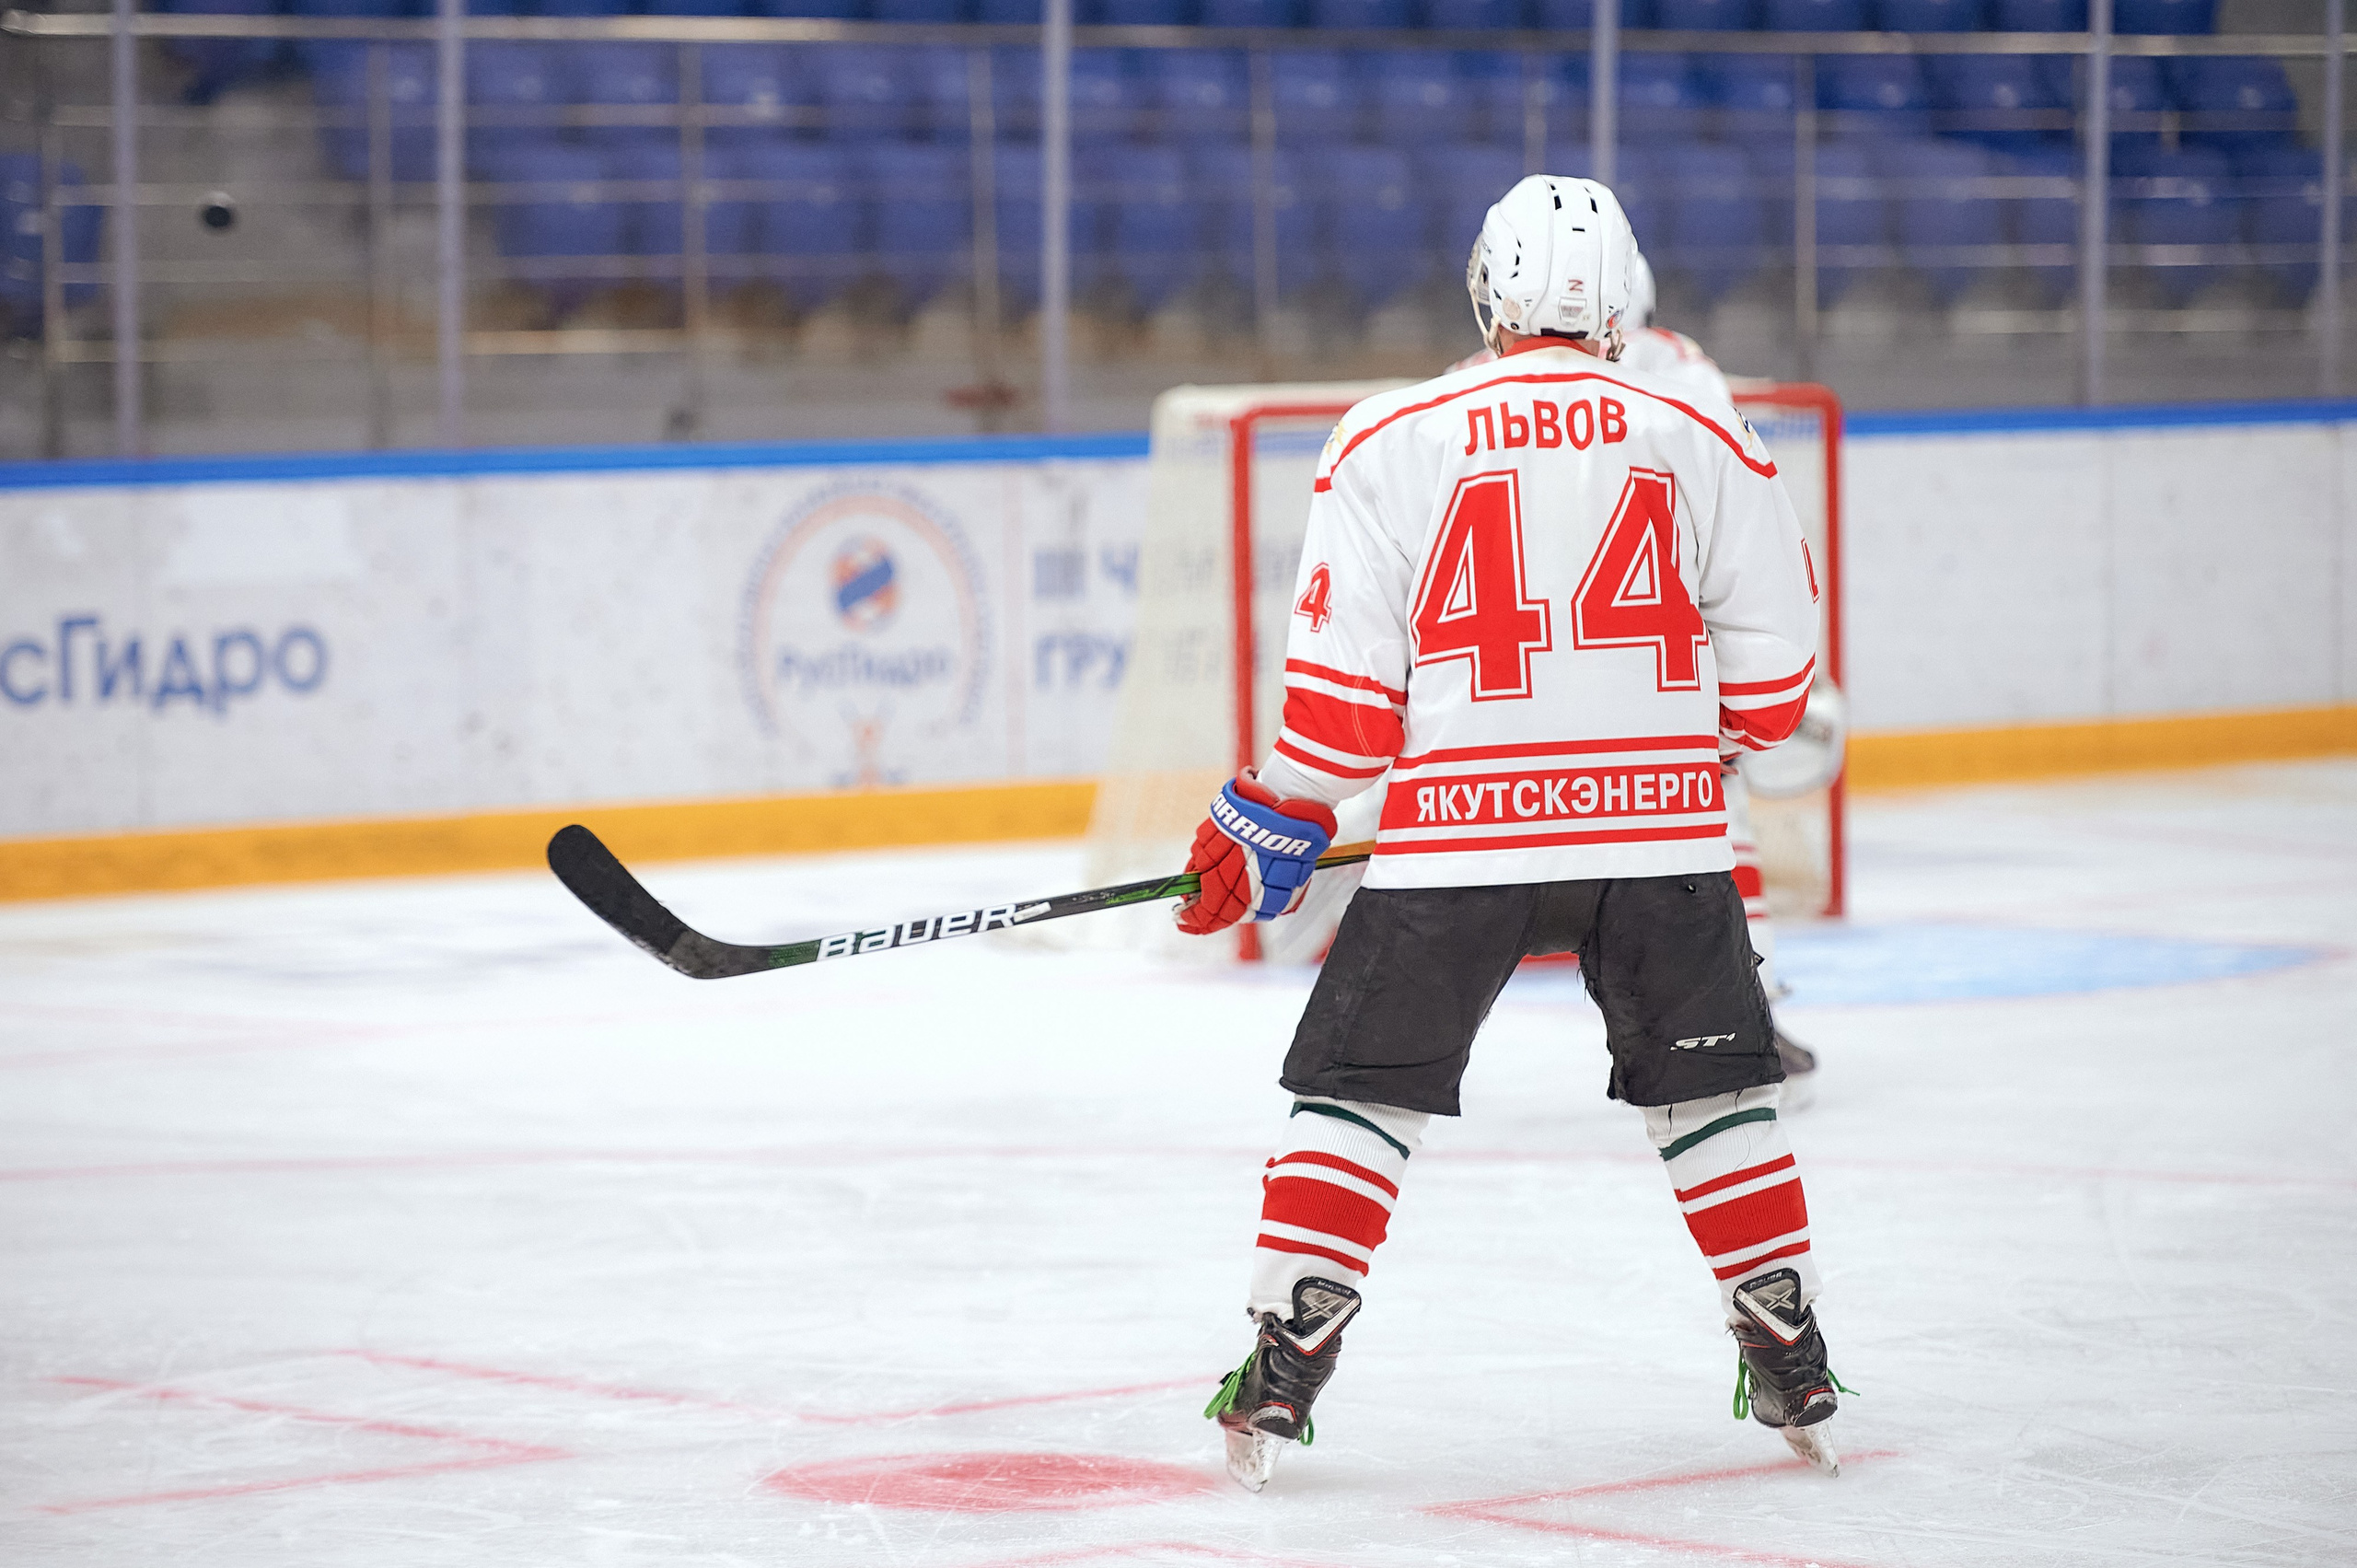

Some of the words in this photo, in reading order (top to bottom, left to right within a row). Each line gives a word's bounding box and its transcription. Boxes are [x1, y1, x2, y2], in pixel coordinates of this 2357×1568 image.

[1465, 396, 1628, 456] ЛЬВОВ
[1411, 466, 1710, 702] 44
[0, 614, 327, 719] сГидро
[1211, 791, 1312, 856] ARRIOR
[1416, 770, 1714, 822] ЯКУТСКЭНЕРГО
[816, 902, 1018, 961] BAUER
